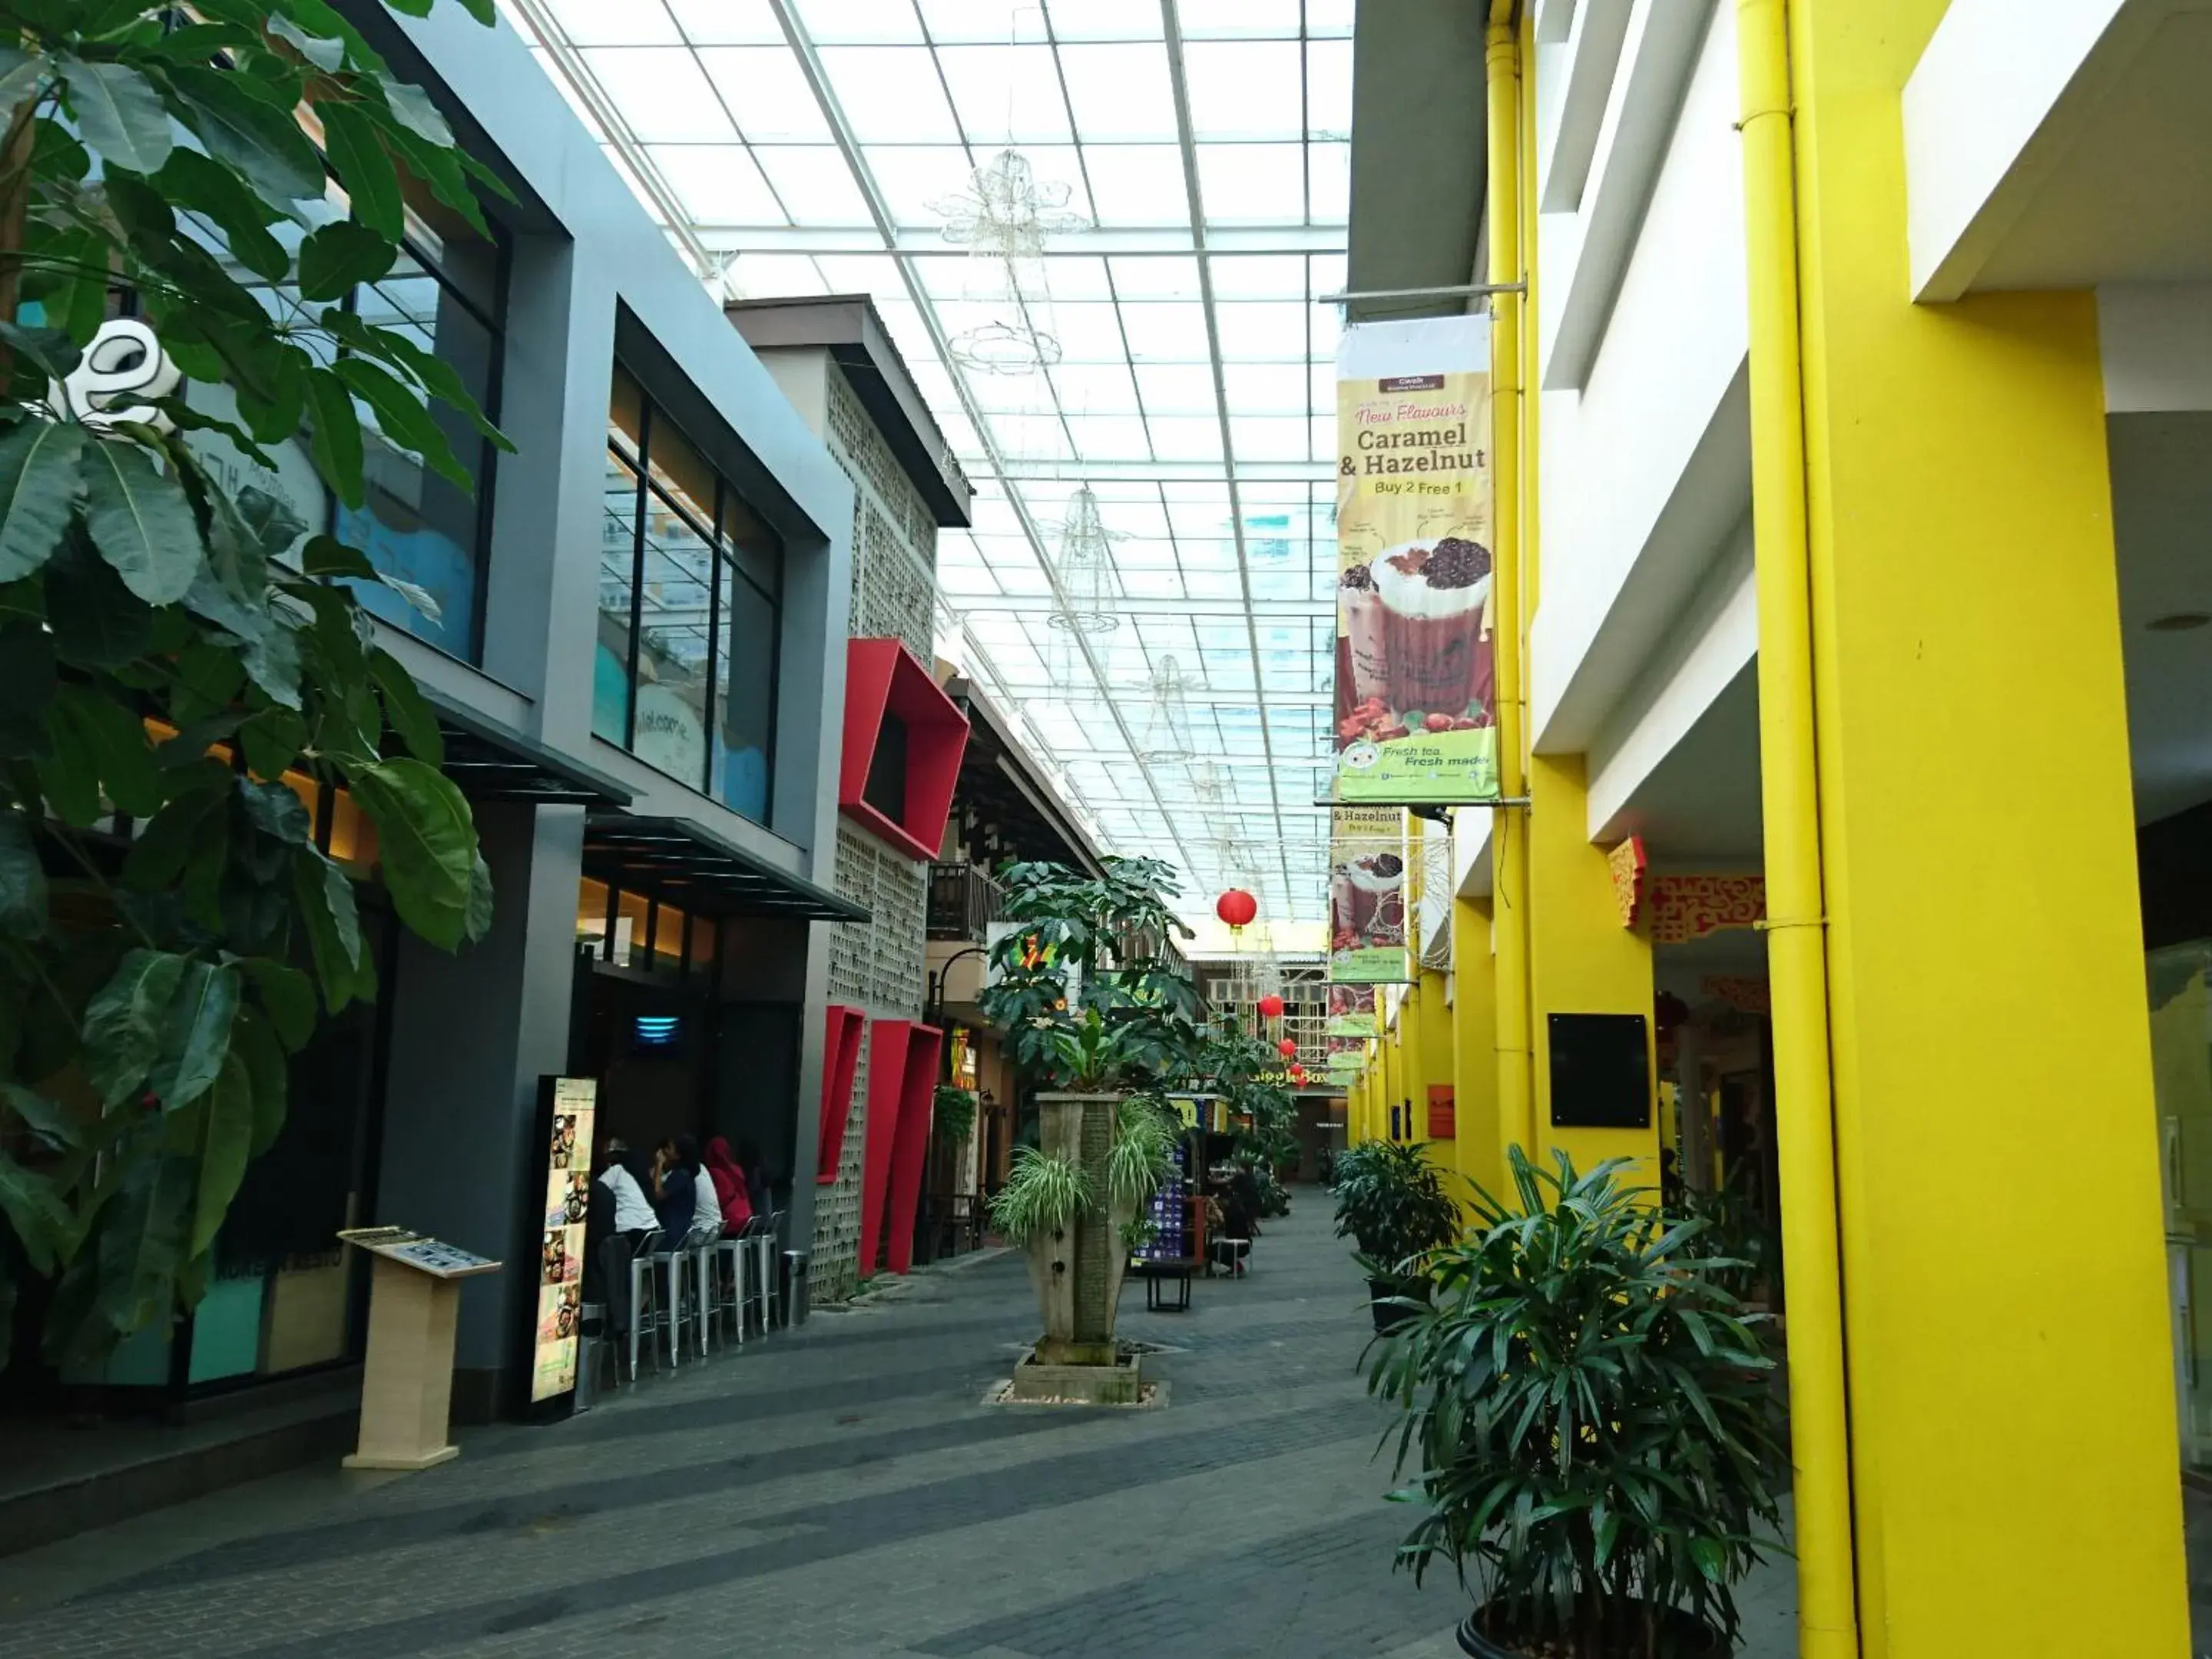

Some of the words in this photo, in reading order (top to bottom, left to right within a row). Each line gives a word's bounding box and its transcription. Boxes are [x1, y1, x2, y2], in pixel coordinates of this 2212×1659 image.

[1355, 408, 1392, 425] New
[1357, 422, 1467, 450] Caramel
[1340, 455, 1356, 476] &
[1364, 449, 1486, 475] Hazelnut
[1375, 482, 1402, 495] Buy
[1406, 482, 1415, 492] 2
[1419, 482, 1450, 495] Free
[1455, 482, 1462, 492] 1
[1382, 747, 1418, 757] Fresh
[1405, 757, 1443, 766] Fresh
[1344, 810, 1401, 822] Hazelnut
